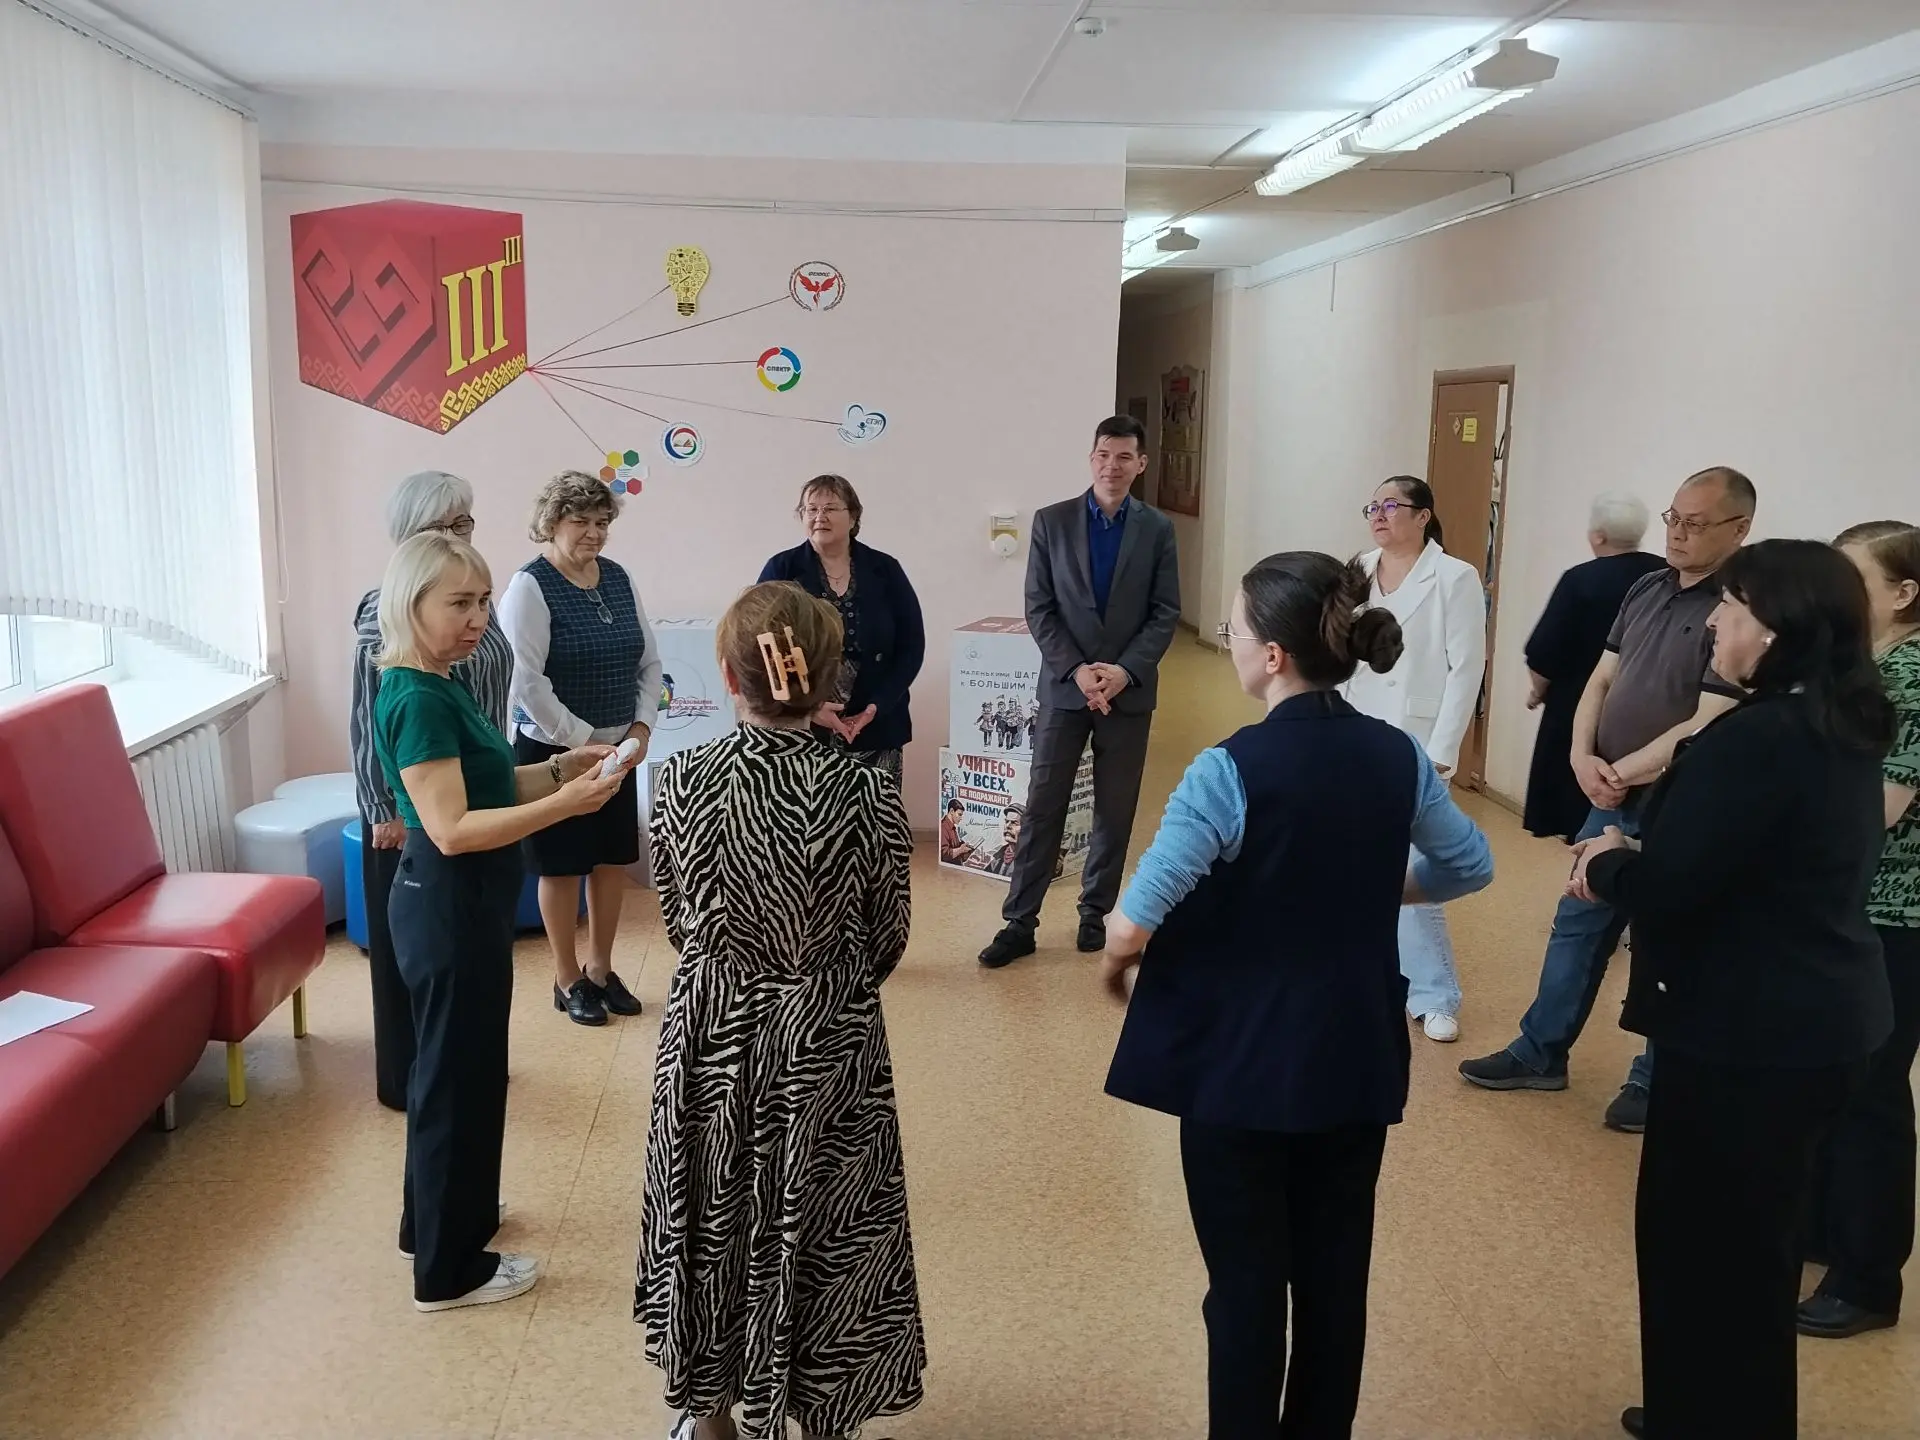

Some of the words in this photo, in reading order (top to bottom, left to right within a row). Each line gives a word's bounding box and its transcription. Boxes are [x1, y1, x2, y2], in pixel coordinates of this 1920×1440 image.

[969, 680, 1026, 690] БОЛЬШИМ
[957, 754, 1016, 778] УЧИТЕСЬ
[963, 771, 971, 784] У
[973, 773, 1010, 794] ВСЕХ,
[960, 789, 968, 798] НЕ
[968, 790, 1009, 805] ПОДРАЖАЙТЕ
[966, 802, 1001, 818] НИКОМУ
